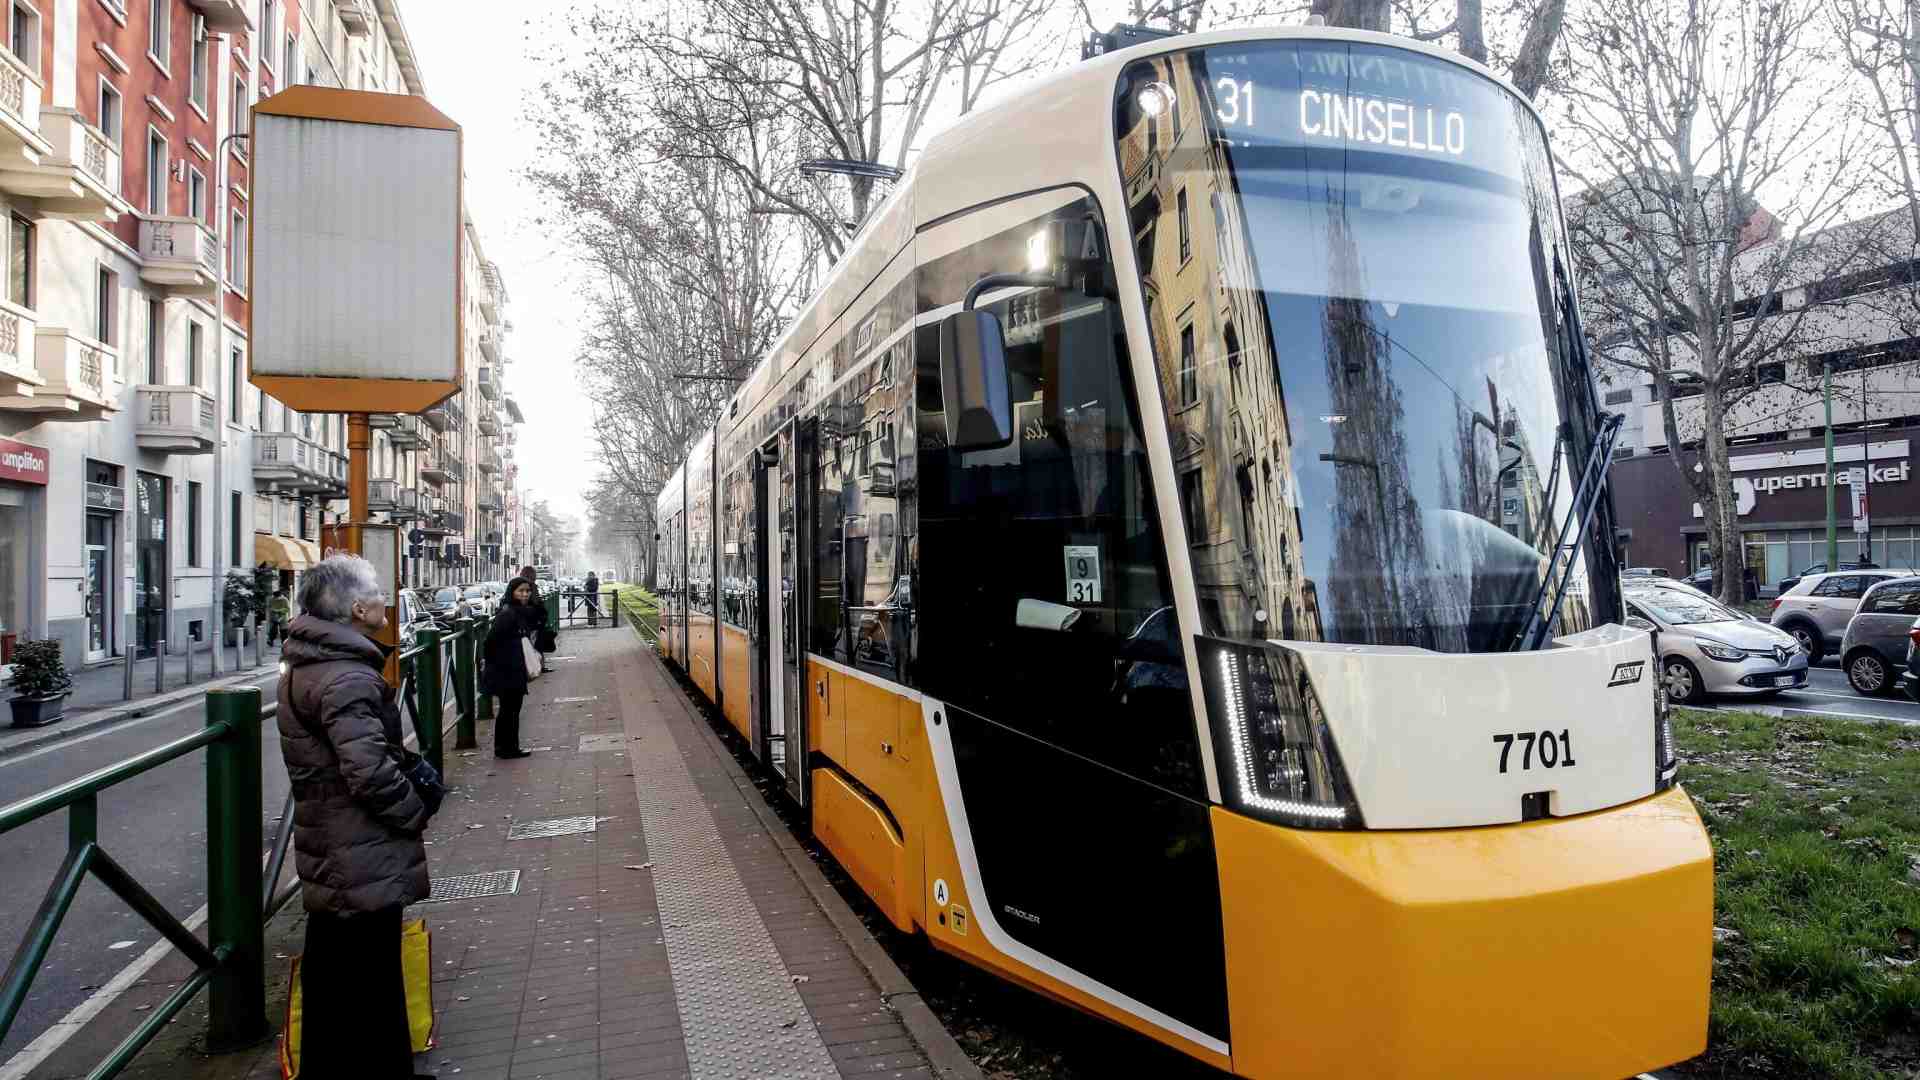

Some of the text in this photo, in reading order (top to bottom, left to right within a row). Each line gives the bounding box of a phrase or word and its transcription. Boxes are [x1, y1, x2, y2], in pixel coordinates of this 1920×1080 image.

[1217, 76, 1465, 156] 31 CINISELLO
[2, 450, 44, 473] amplifon
[1076, 558, 1089, 578] 9
[1073, 582, 1094, 603] 31
[1493, 729, 1576, 774] 7701
[936, 883, 946, 902] A
